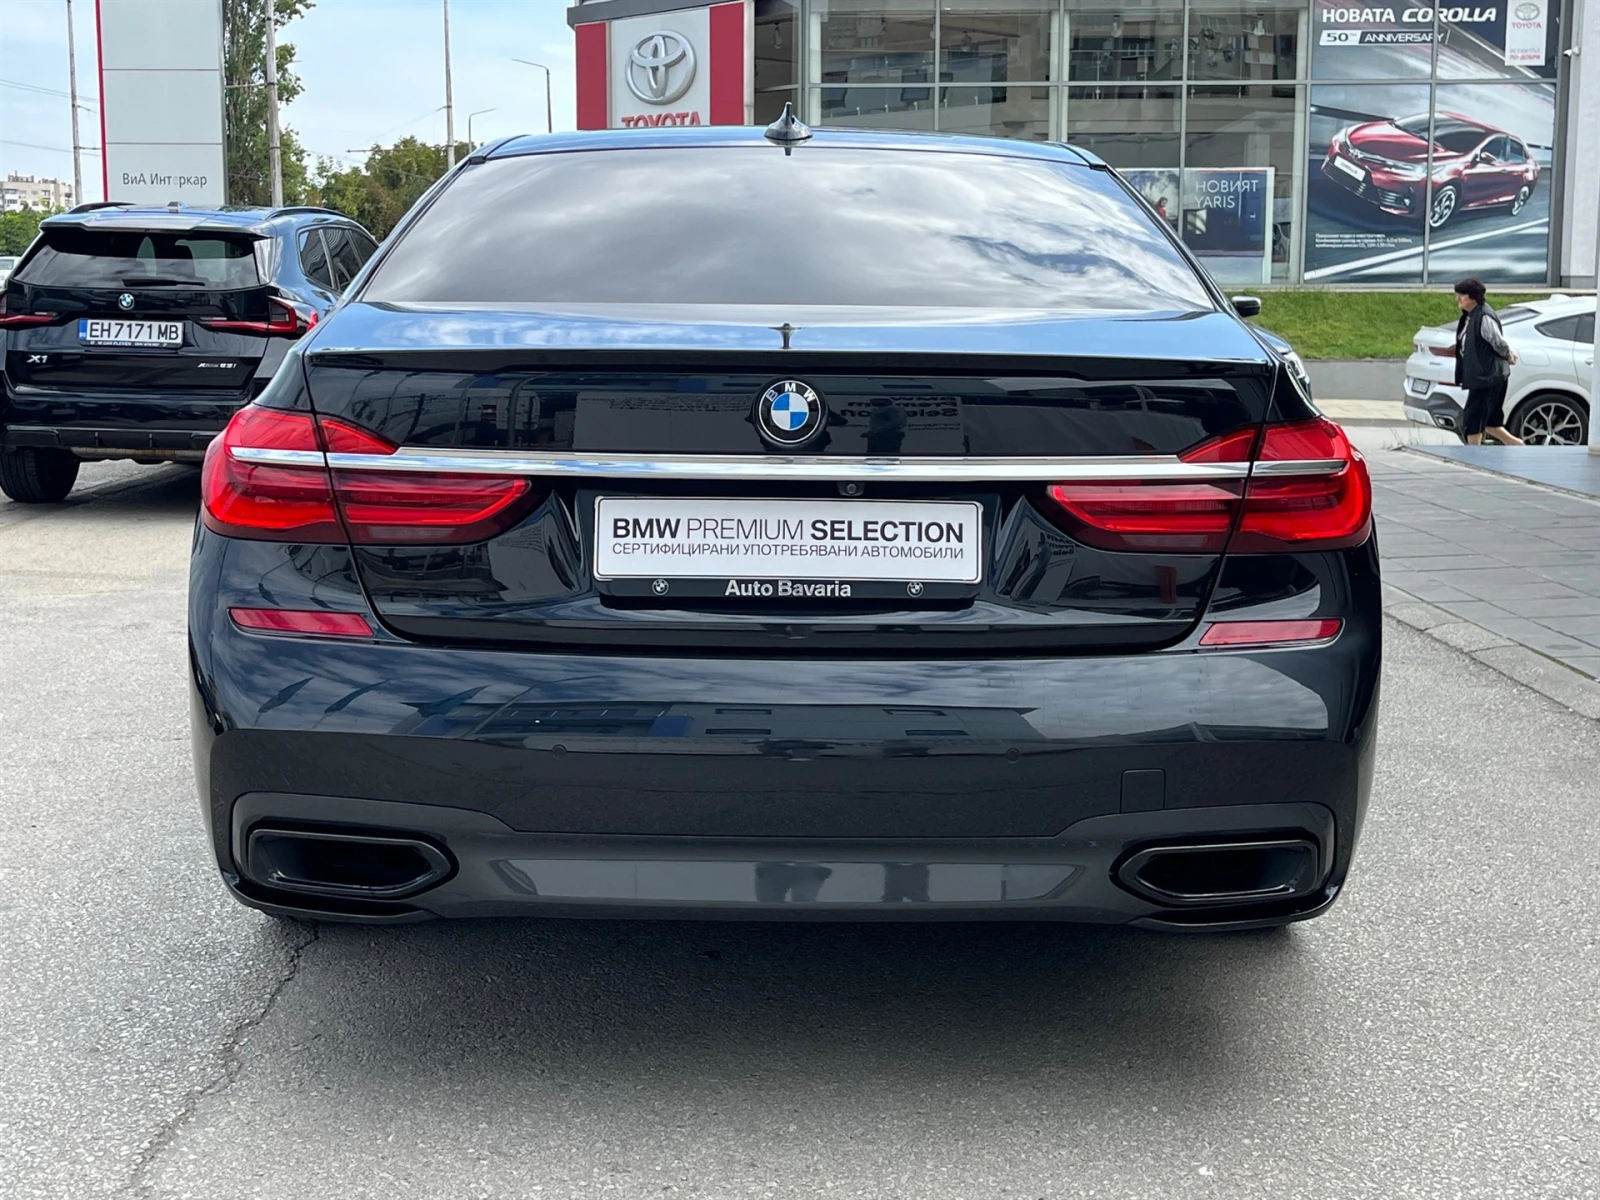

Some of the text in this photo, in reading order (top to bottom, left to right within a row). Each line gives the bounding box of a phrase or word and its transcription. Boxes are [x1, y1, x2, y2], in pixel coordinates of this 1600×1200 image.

[1322, 7, 1497, 23] НОВАТА COROLLA
[621, 111, 701, 128] TOYOTA
[122, 172, 147, 185] ВиА
[1195, 179, 1260, 193] НОВИЯТ
[1194, 195, 1236, 209] YARIS
[26, 354, 48, 363] X1
[765, 382, 817, 402] BMW
[612, 517, 964, 543] BMW PREMIUM SELECTION
[612, 542, 964, 559] СЕРТИФИЦИРАНИ УПОТРЕБЯВАНИ АВТОМОБИЛИ
[724, 579, 852, 597] Auto Bavaria
